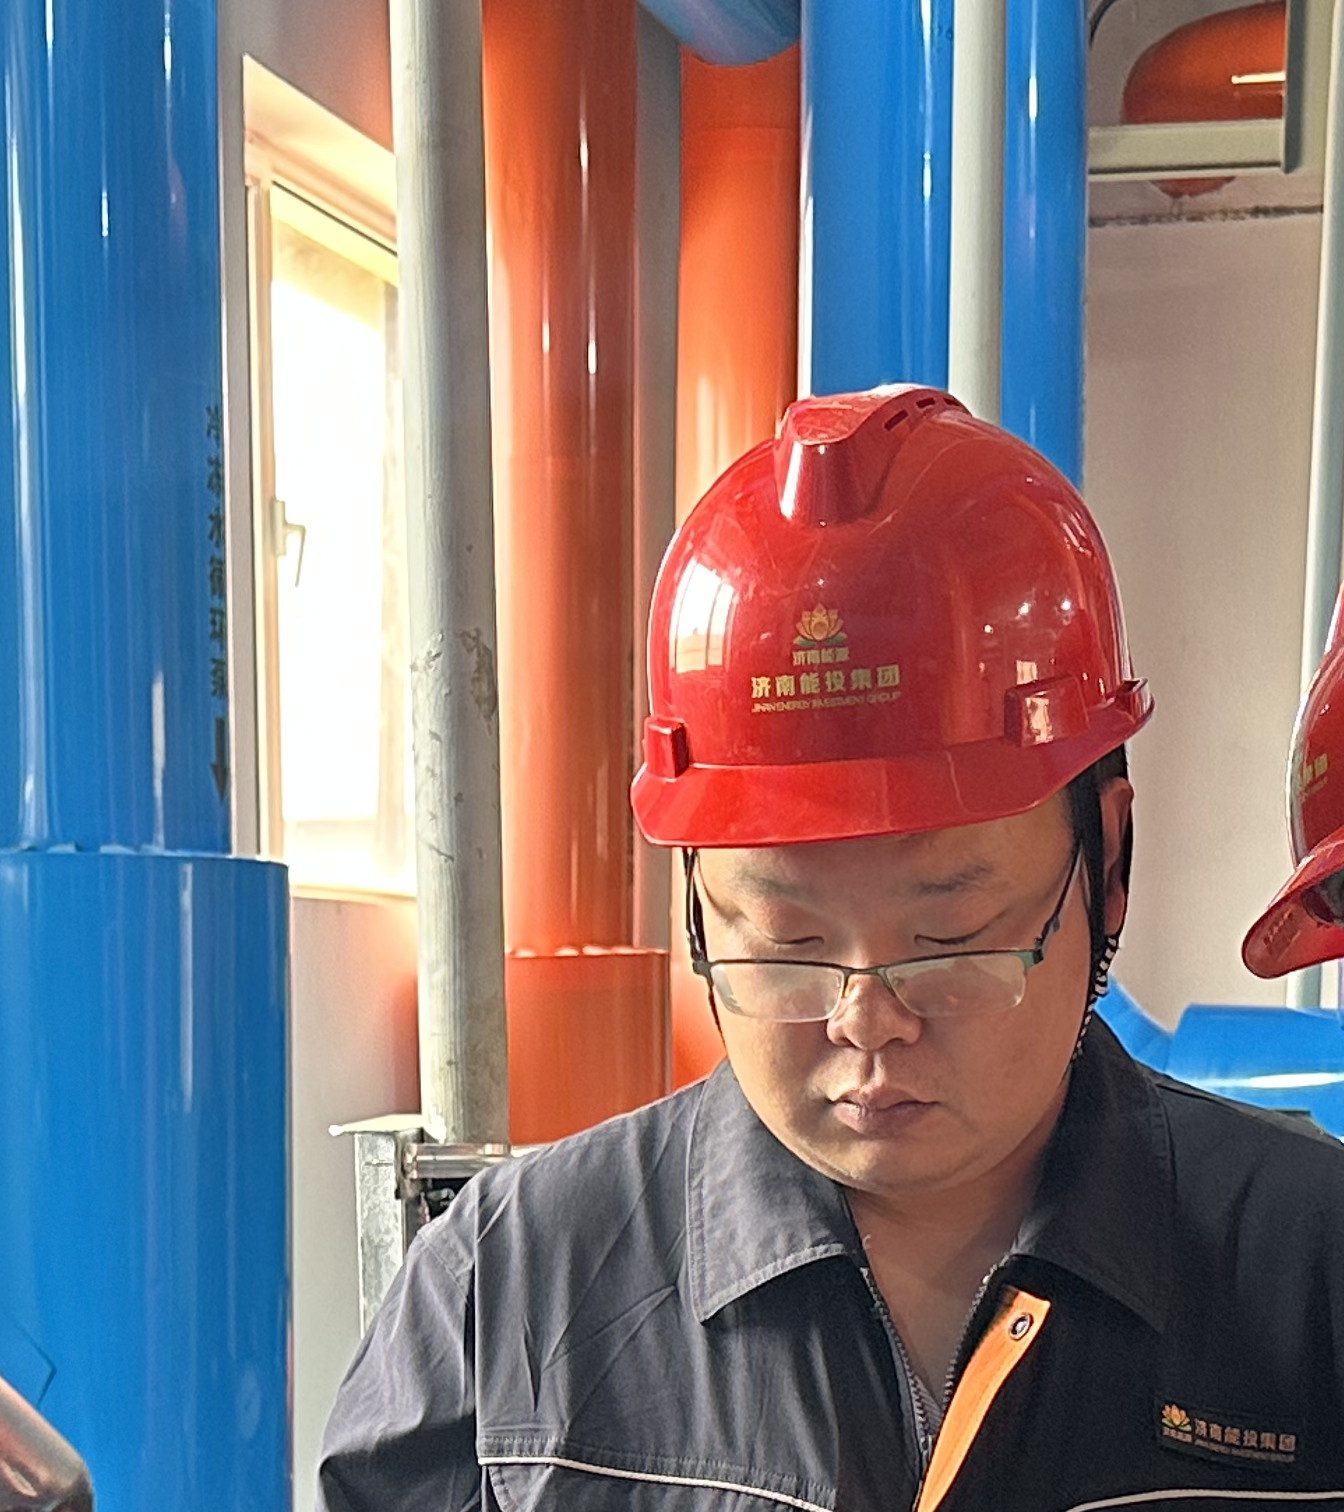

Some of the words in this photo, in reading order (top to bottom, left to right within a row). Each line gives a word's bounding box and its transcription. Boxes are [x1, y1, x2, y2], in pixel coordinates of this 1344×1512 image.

[751, 664, 900, 698] 济南能投集团
